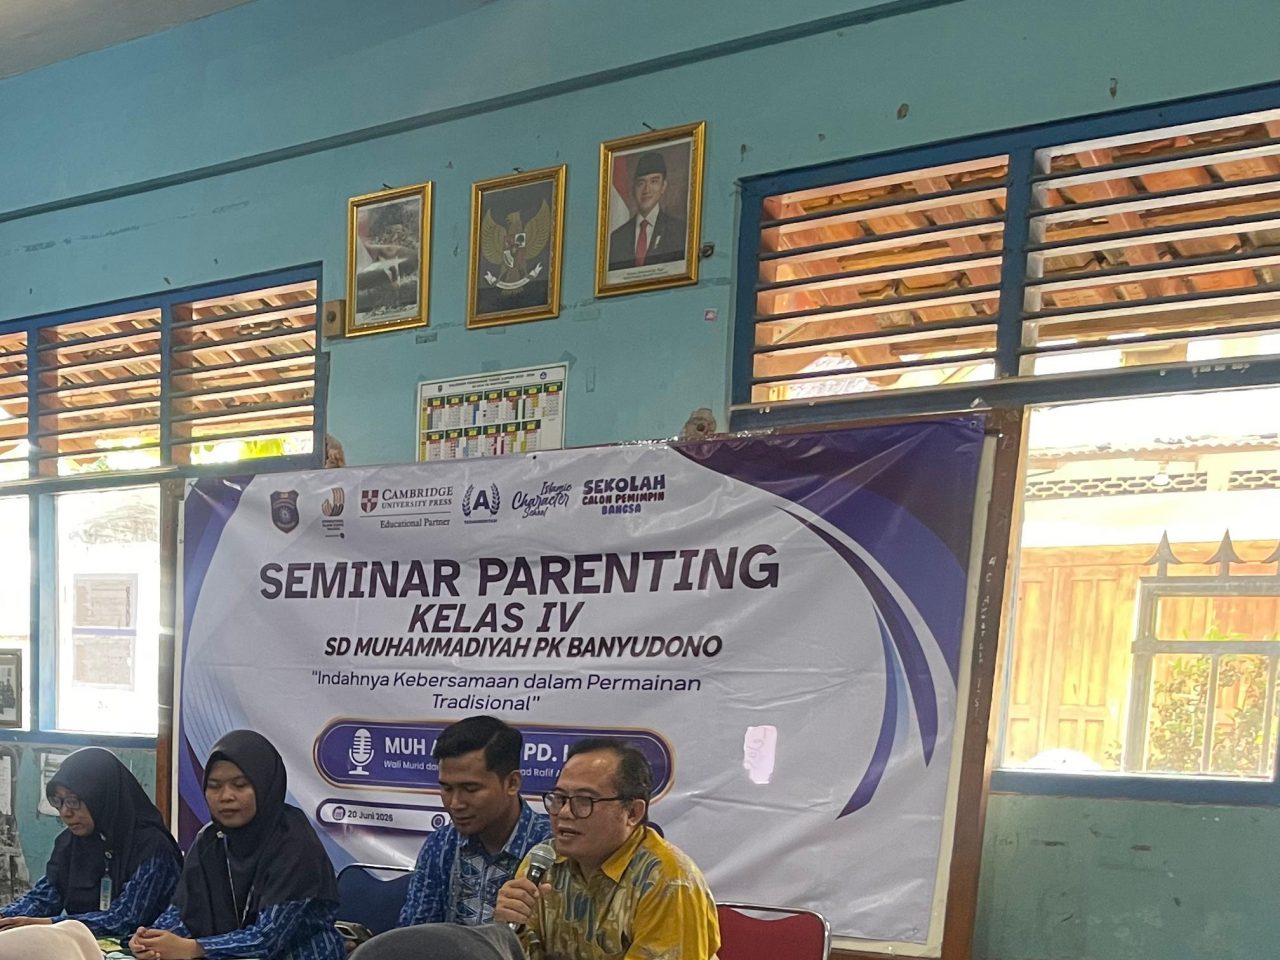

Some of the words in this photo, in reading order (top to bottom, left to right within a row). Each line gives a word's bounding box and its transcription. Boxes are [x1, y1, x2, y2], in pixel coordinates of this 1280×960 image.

[382, 486, 453, 501] CAMBRIDGE
[582, 474, 666, 495] SEKOLAH
[381, 500, 427, 509] UNIVERSITY
[428, 498, 452, 507] PRESS
[473, 490, 490, 510] A
[582, 494, 613, 506] CALON
[614, 491, 665, 504] PEMIMPIN
[601, 504, 642, 515] BANGSA
[380, 518, 421, 529] Educational
[423, 517, 451, 528] Partner
[260, 559, 461, 600] SEMINAR
[478, 544, 780, 597] PARENTING
[408, 602, 524, 634] KELAS
[536, 601, 585, 633] IV
[324, 637, 351, 658] SD
[354, 636, 532, 658] MUHAMMADIYAH
[532, 636, 566, 657] PK
[567, 635, 723, 658] BANYUDONO
[312, 671, 389, 689] "Indahnya
[393, 672, 519, 690] Kebersamaan
[524, 674, 583, 690] dalam
[587, 675, 701, 692] Permainan
[432, 693, 540, 711] Tradisional"
[385, 737, 426, 756] MUH
[384, 760, 401, 769] Wali
[402, 761, 424, 770] Murid
[533, 768, 554, 777] Rafif
[347, 809, 357, 818] 20
[359, 811, 375, 820] Juni
